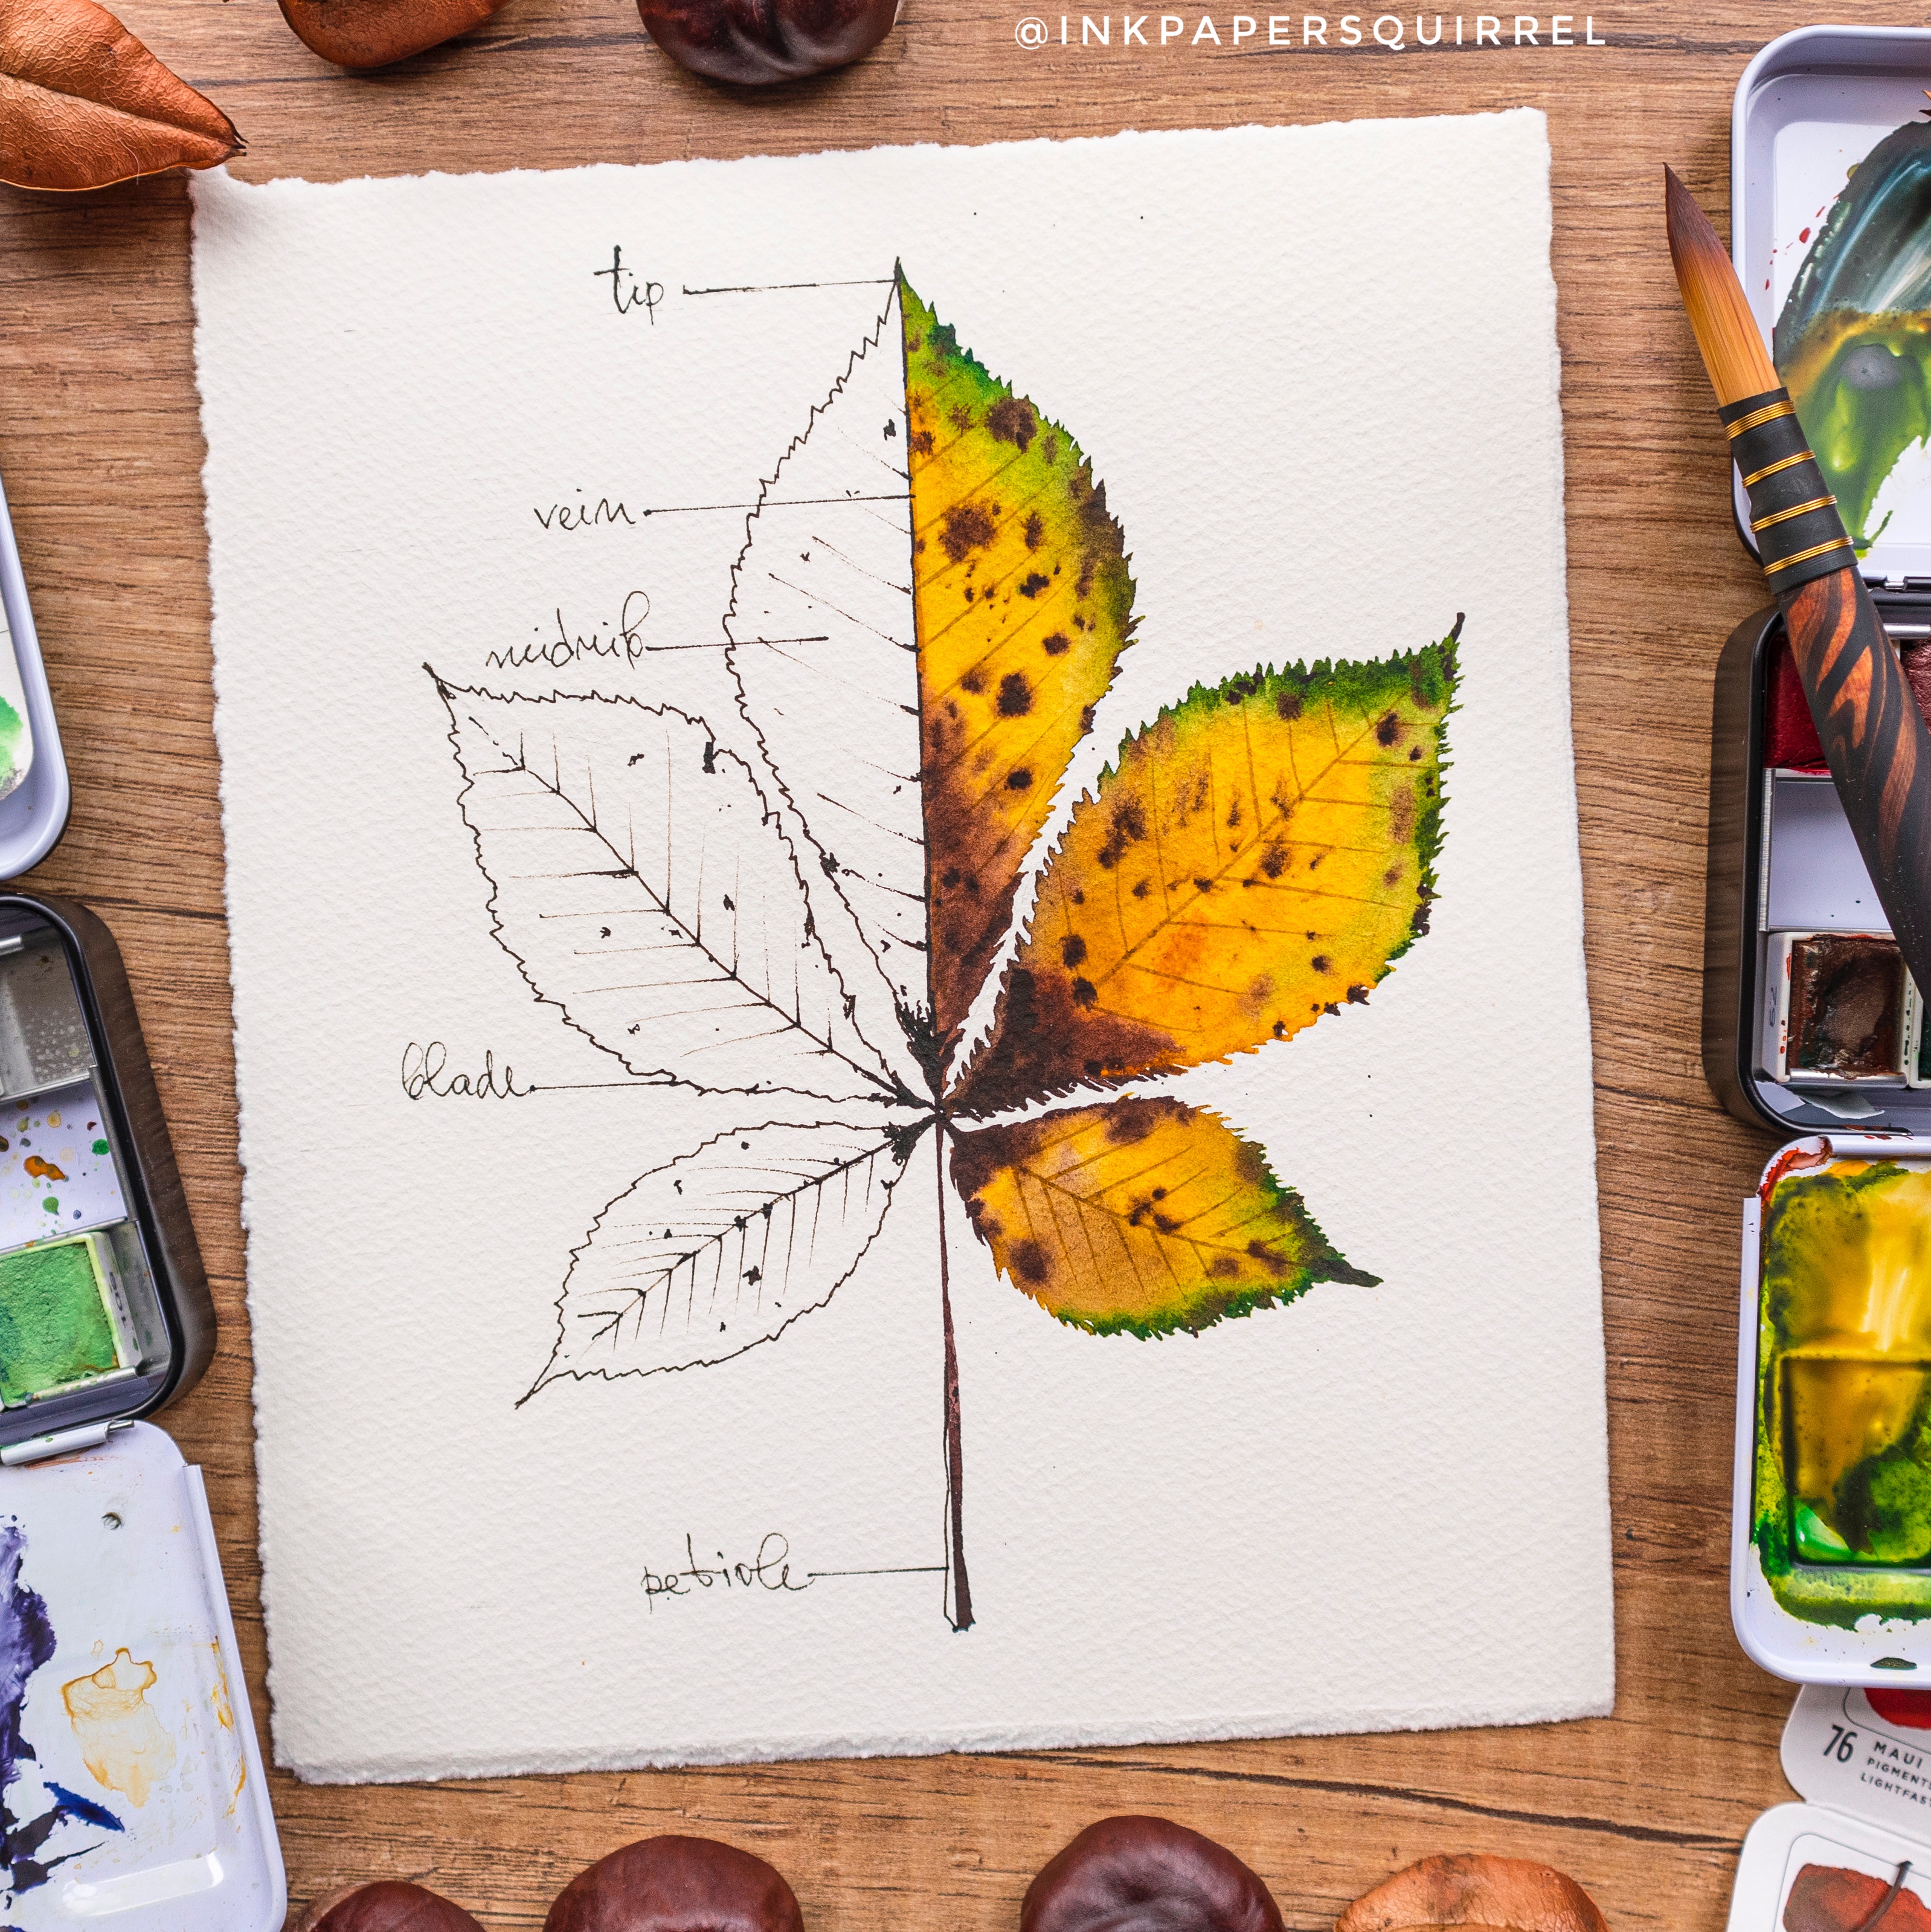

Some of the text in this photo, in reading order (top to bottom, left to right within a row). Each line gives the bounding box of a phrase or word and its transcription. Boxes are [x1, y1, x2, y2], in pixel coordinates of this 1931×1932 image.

[593, 244, 664, 326] tip
[534, 488, 637, 531] vein
[485, 590, 651, 671] midrib
[402, 1041, 532, 1100] blade
[640, 1533, 815, 1615] petiole
[1823, 1724, 1923, 1769] 76 MAUI
[1861, 1772, 1931, 1808] LIGHTFAS
